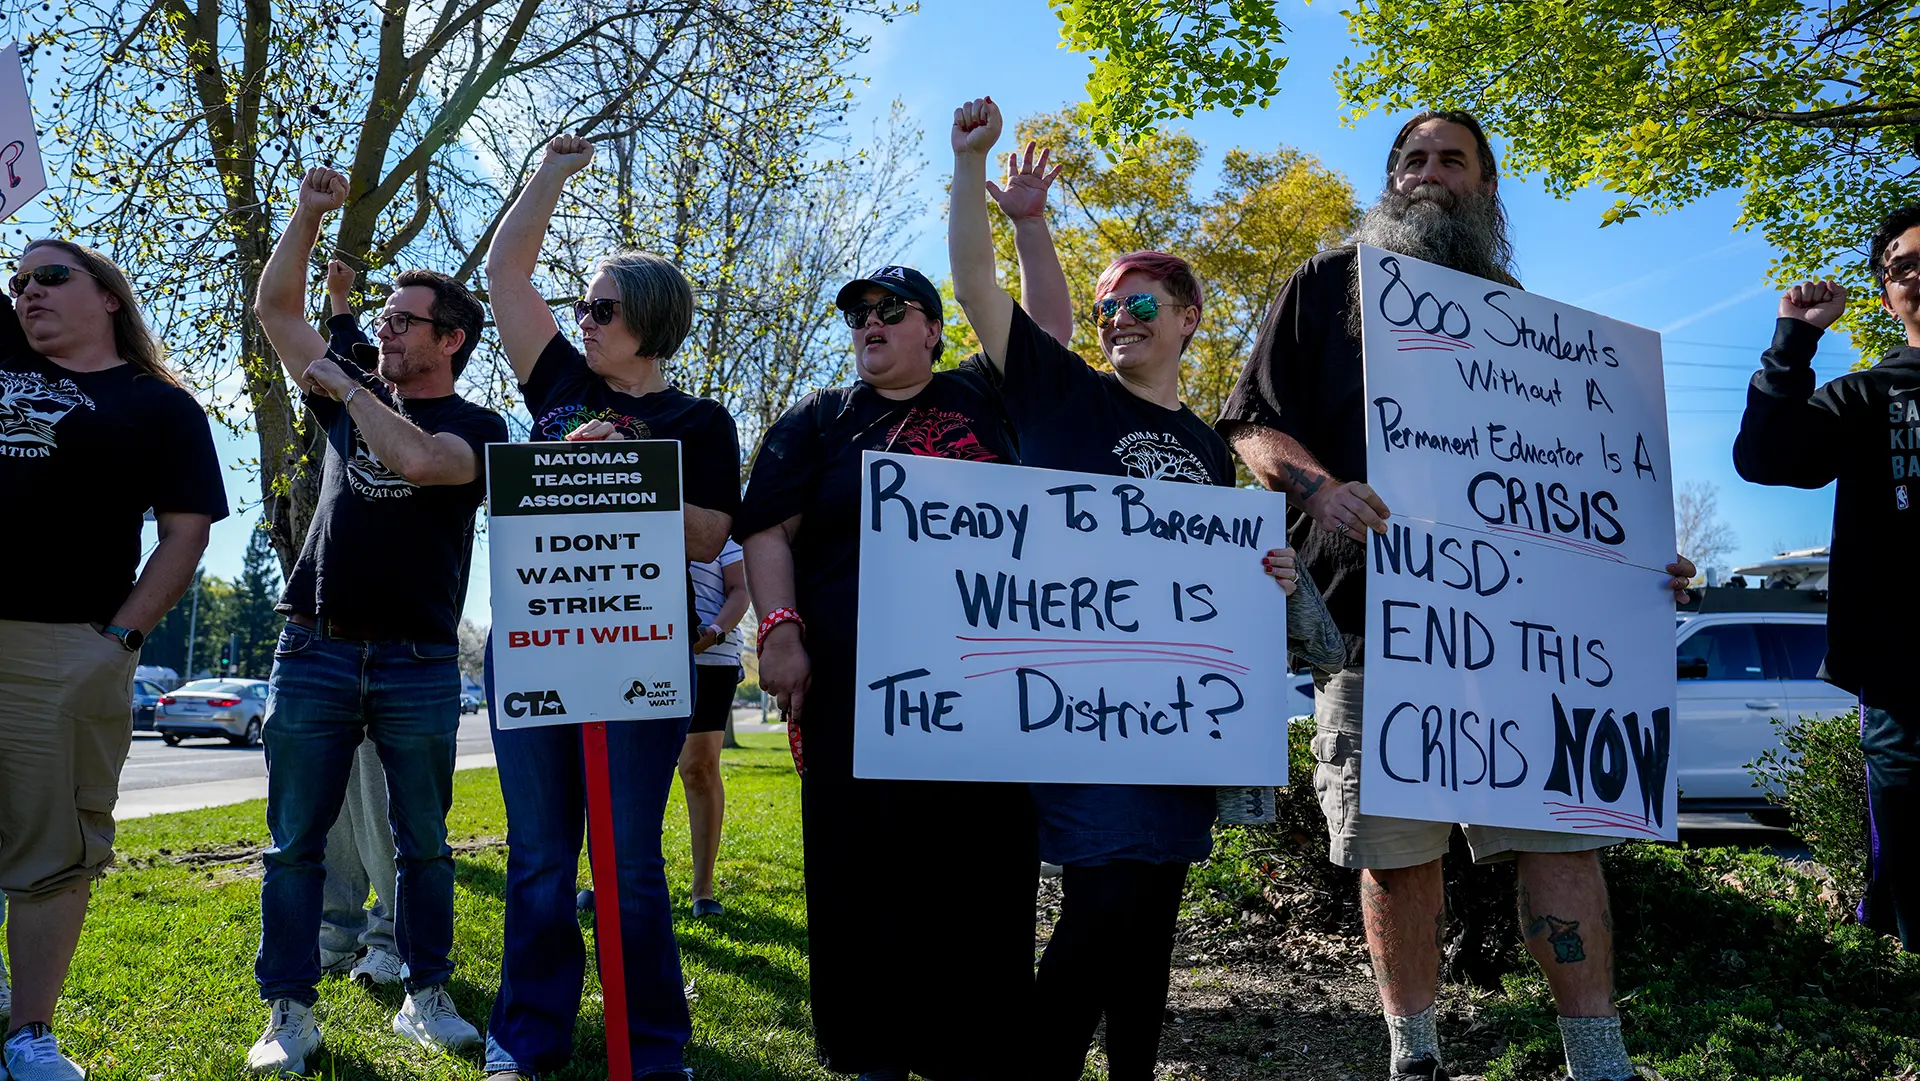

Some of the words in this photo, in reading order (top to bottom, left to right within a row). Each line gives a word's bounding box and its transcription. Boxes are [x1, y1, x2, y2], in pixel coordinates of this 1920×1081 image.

[1379, 256, 1471, 339] 800
[1483, 290, 1619, 368] Students
[1455, 358, 1562, 407] Without
[1586, 377, 1614, 414] A
[1111, 430, 1160, 456] NATOMAS
[1373, 396, 1479, 456] Permanent
[1487, 421, 1583, 467] Educator
[1632, 431, 1656, 482] A
[534, 452, 639, 466] NATOMAS
[531, 472, 643, 487] TEACHERS
[518, 492, 657, 508] ASSOCIATION
[1467, 471, 1626, 545] CRISIS
[535, 536, 543, 553] I
[550, 533, 641, 552] DON'T
[1372, 522, 1523, 597] NUSD:
[516, 567, 615, 585] WANT
[621, 563, 661, 580] TO
[955, 569, 1140, 633] WHERE
[1172, 581, 1219, 623] IS
[508, 629, 571, 648] BUT
[576, 627, 585, 645] I
[589, 623, 674, 643] WILL!
[1382, 599, 1495, 671] END
[1509, 620, 1613, 688] THIS
[653, 681, 671, 689] WE
[504, 690, 567, 718] CTA
[649, 699, 676, 707] WAIT
[868, 667, 964, 737] THE
[1015, 667, 1245, 742] District?
[1379, 701, 1528, 791] CRISIS
[1543, 692, 1670, 829] NOW
